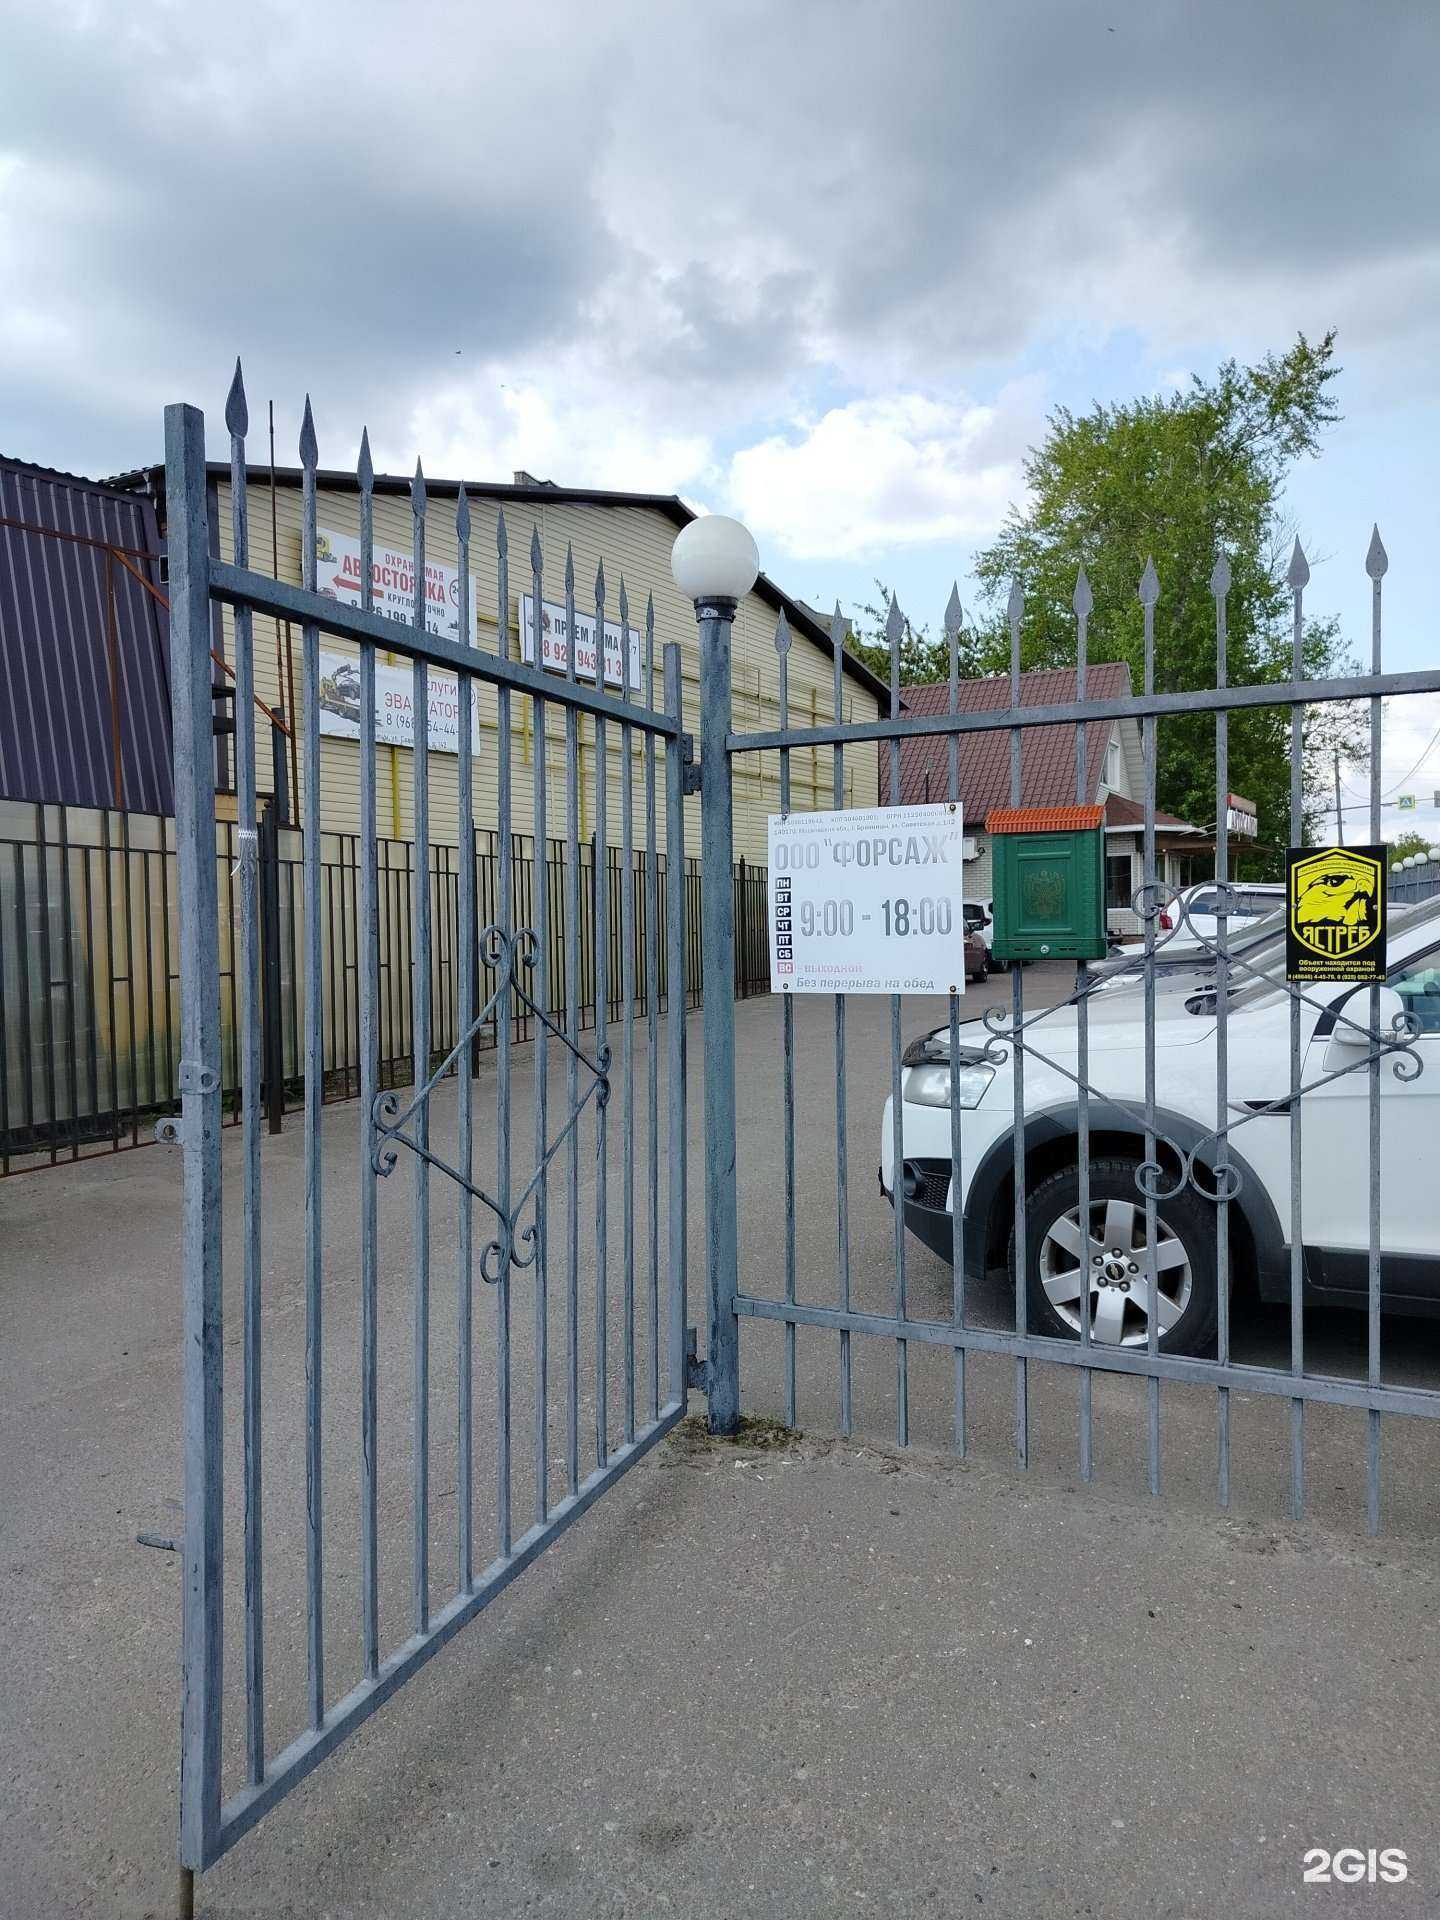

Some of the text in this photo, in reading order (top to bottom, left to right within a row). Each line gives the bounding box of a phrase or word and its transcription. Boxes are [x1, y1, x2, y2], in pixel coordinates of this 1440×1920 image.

[385, 553, 444, 581] ОХРАНМАЯ
[554, 618, 589, 643] ПРЕМ
[592, 628, 619, 652] ЛМА
[543, 639, 550, 657] 8
[386, 712, 392, 726] 8
[775, 841, 820, 870] ООО
[777, 879, 790, 888] ПН
[777, 893, 790, 902] ВТ
[777, 907, 790, 917] СР
[800, 898, 855, 937] 9:00
[881, 897, 952, 937] 18:00
[778, 921, 790, 931] ЧТ
[778, 935, 790, 944] ПТ
[1302, 926, 1371, 953] ЯСТРЕБ
[779, 949, 791, 959] СБ
[778, 963, 792, 973] ВС
[1298, 959, 1376, 968] Объект находится под
[797, 977, 935, 990] Без перерыва на обед
